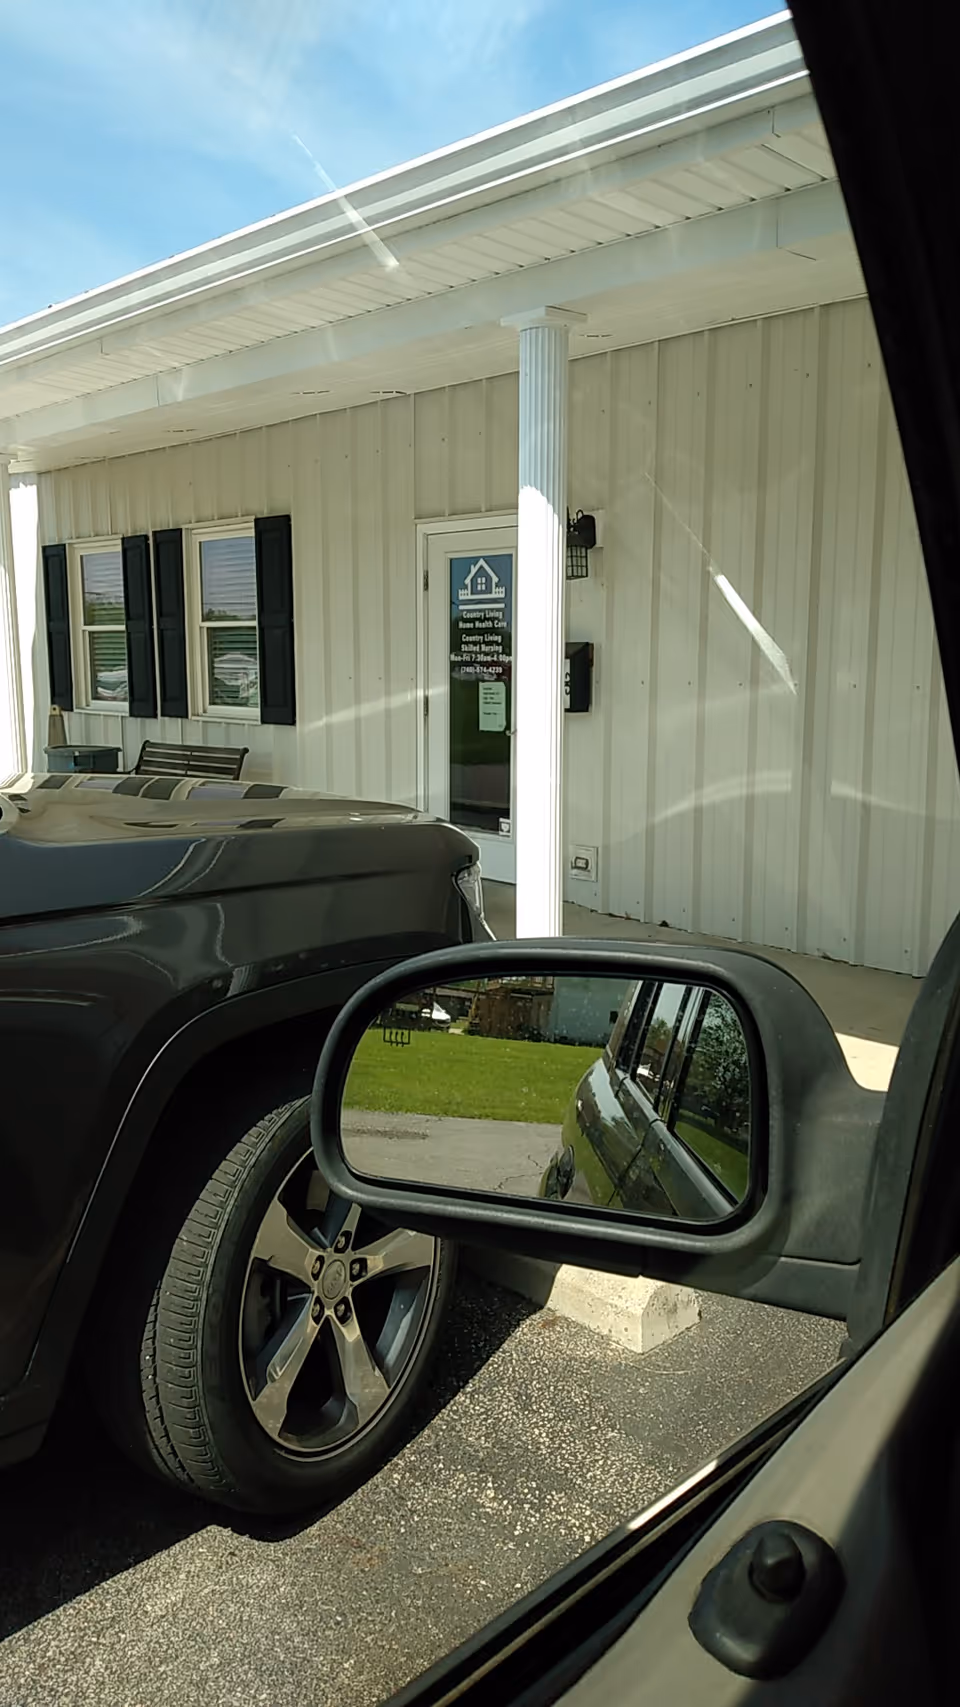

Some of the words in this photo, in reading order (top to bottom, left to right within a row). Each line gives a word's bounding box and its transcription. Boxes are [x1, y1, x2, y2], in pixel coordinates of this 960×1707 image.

[462, 611, 484, 620] Country
[485, 610, 503, 619] Living
[458, 621, 474, 629] Home
[475, 620, 493, 628] Health
[494, 620, 508, 628] Care
[461, 634, 484, 643] Country
[484, 633, 502, 643] Living
[461, 644, 480, 652] Skilled
[481, 643, 503, 653] Nursing
